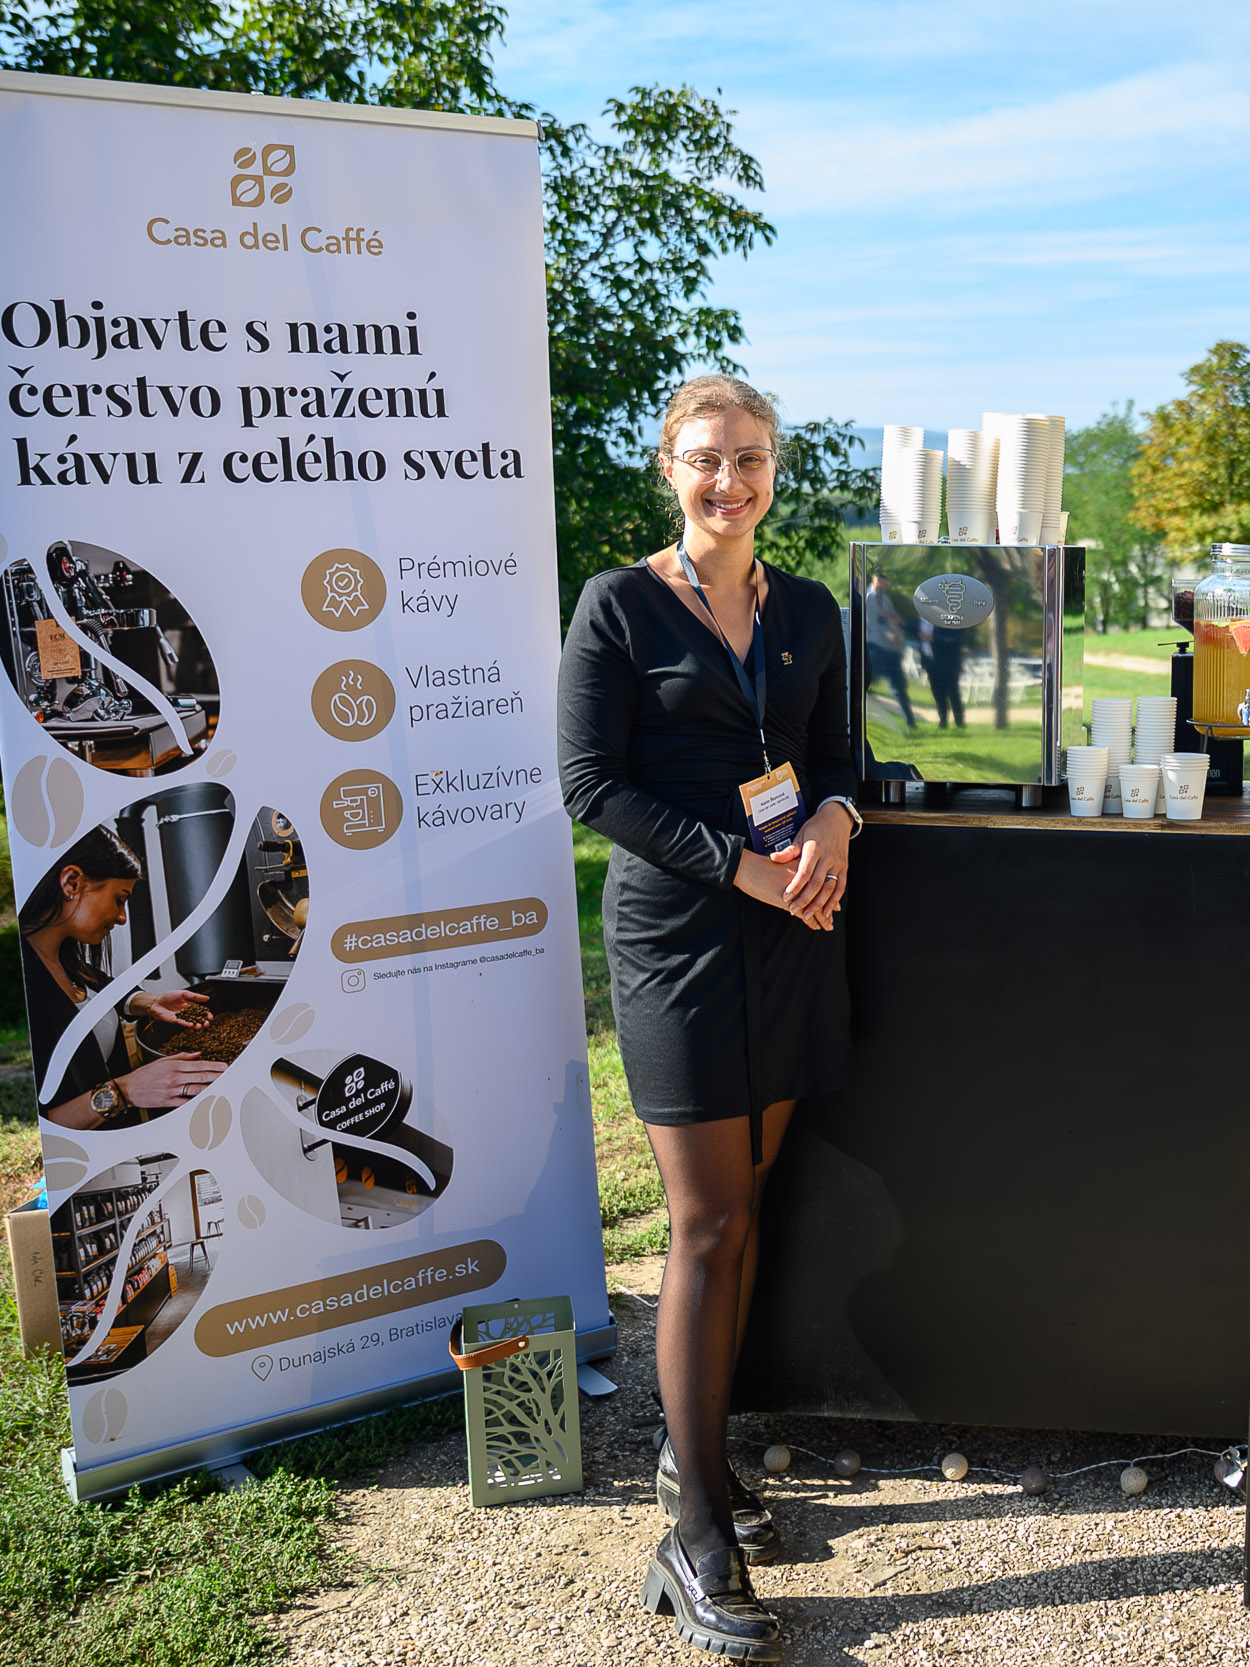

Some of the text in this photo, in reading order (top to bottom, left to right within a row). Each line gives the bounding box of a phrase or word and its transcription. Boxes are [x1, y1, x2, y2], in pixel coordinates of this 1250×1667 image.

[146, 216, 385, 257] Casa del Caffé
[1, 298, 423, 360] Objavte s nami
[8, 365, 449, 428] čerstvo praženú
[14, 433, 525, 487] kávu z celého sveta
[399, 552, 517, 580] Prémiové
[401, 589, 458, 618] kávy
[405, 660, 501, 688] Vlastná
[409, 690, 524, 728] pražiareň
[415, 766, 542, 797] Exkluzívne
[416, 800, 526, 829] kávovary
[343, 910, 538, 952] #casadelcaffe_ba
[373, 947, 545, 981] Sledujte nás na Instagrame @casadelcaffe_ba
[322, 1078, 396, 1121] Casa del Caffé
[336, 1102, 386, 1131] COFFEE SHOP
[225, 1257, 481, 1336] www.casadelcaffe.sk
[279, 1311, 464, 1373] Dunajská 29, Bratislava
